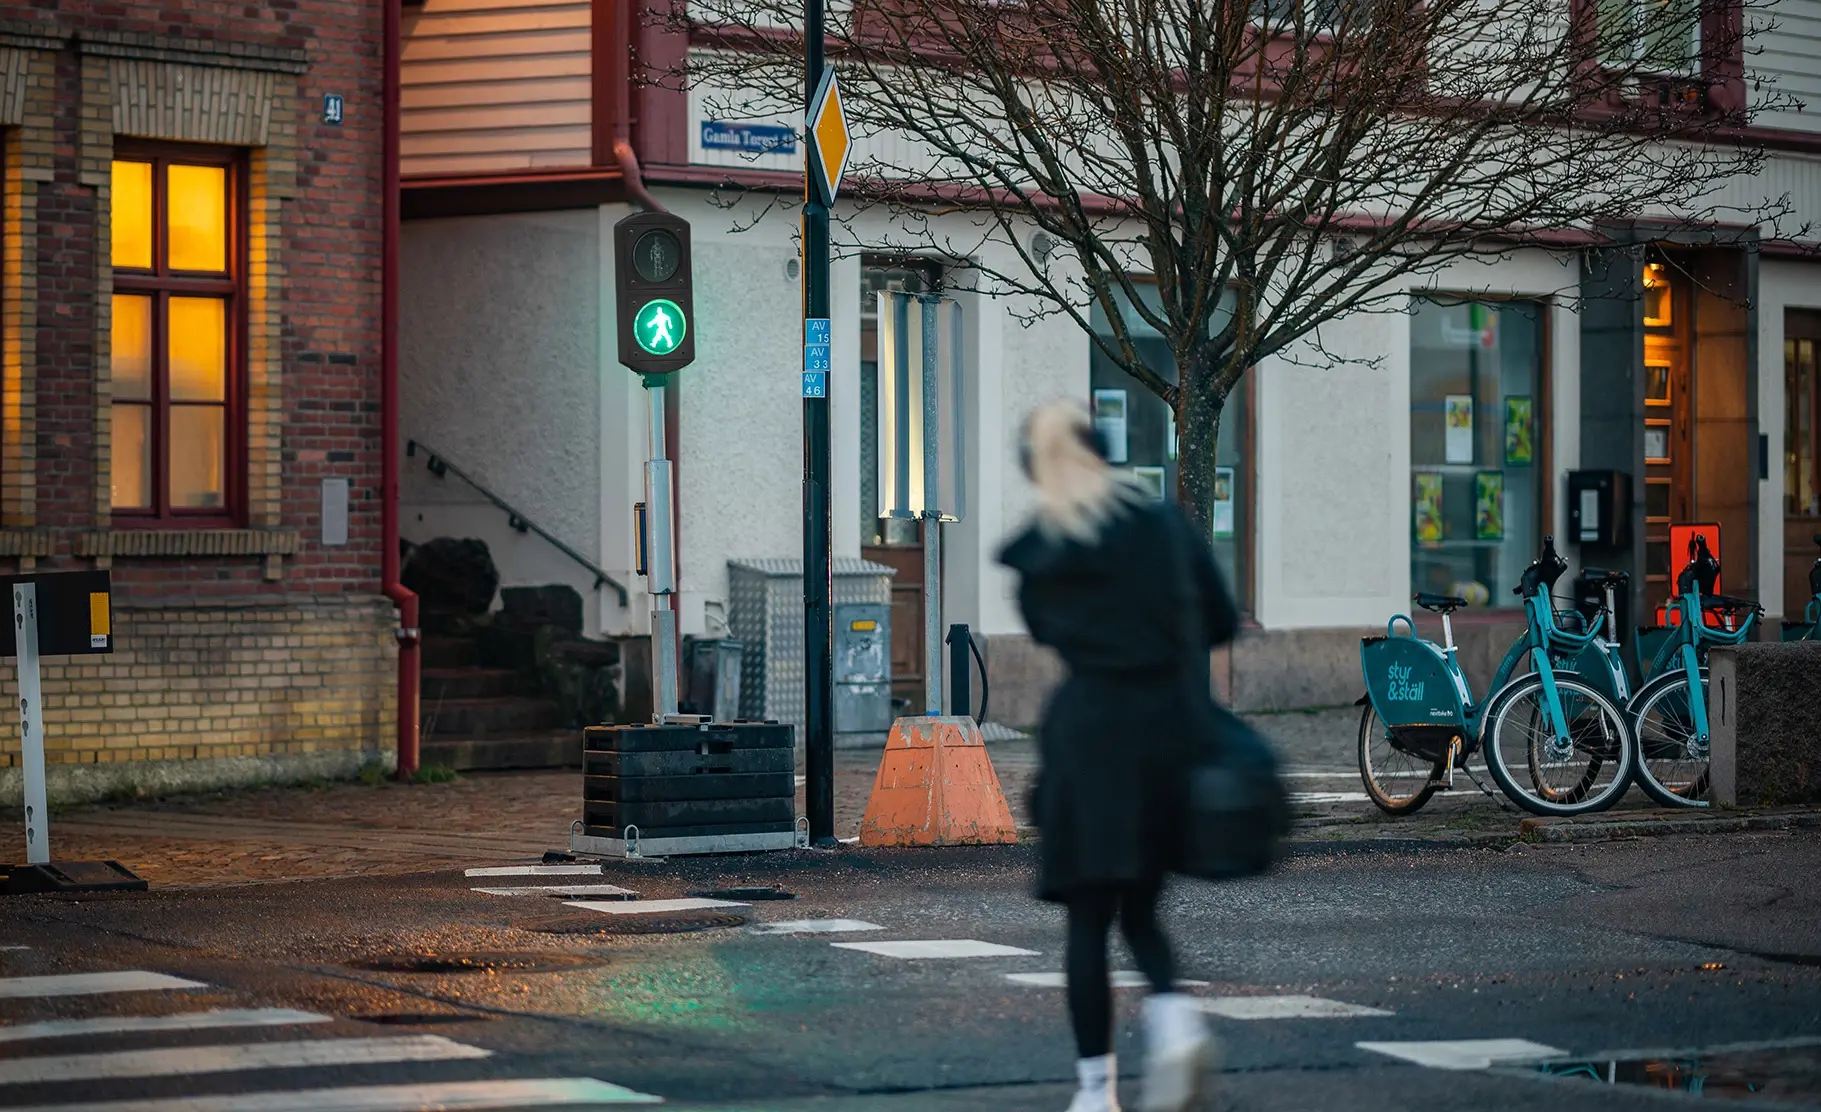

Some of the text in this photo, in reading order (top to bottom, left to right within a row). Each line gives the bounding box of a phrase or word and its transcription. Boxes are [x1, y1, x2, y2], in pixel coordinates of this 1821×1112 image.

[703, 127, 740, 145] Gamla
[743, 130, 779, 150] Torget
[812, 321, 826, 331] AV
[818, 333, 829, 343] 15
[810, 347, 825, 357] AV
[813, 359, 828, 369] 33
[804, 373, 817, 383] AV
[805, 386, 821, 396] 46
[1388, 660, 1413, 686] styr
[1387, 681, 1425, 701] &ställ
